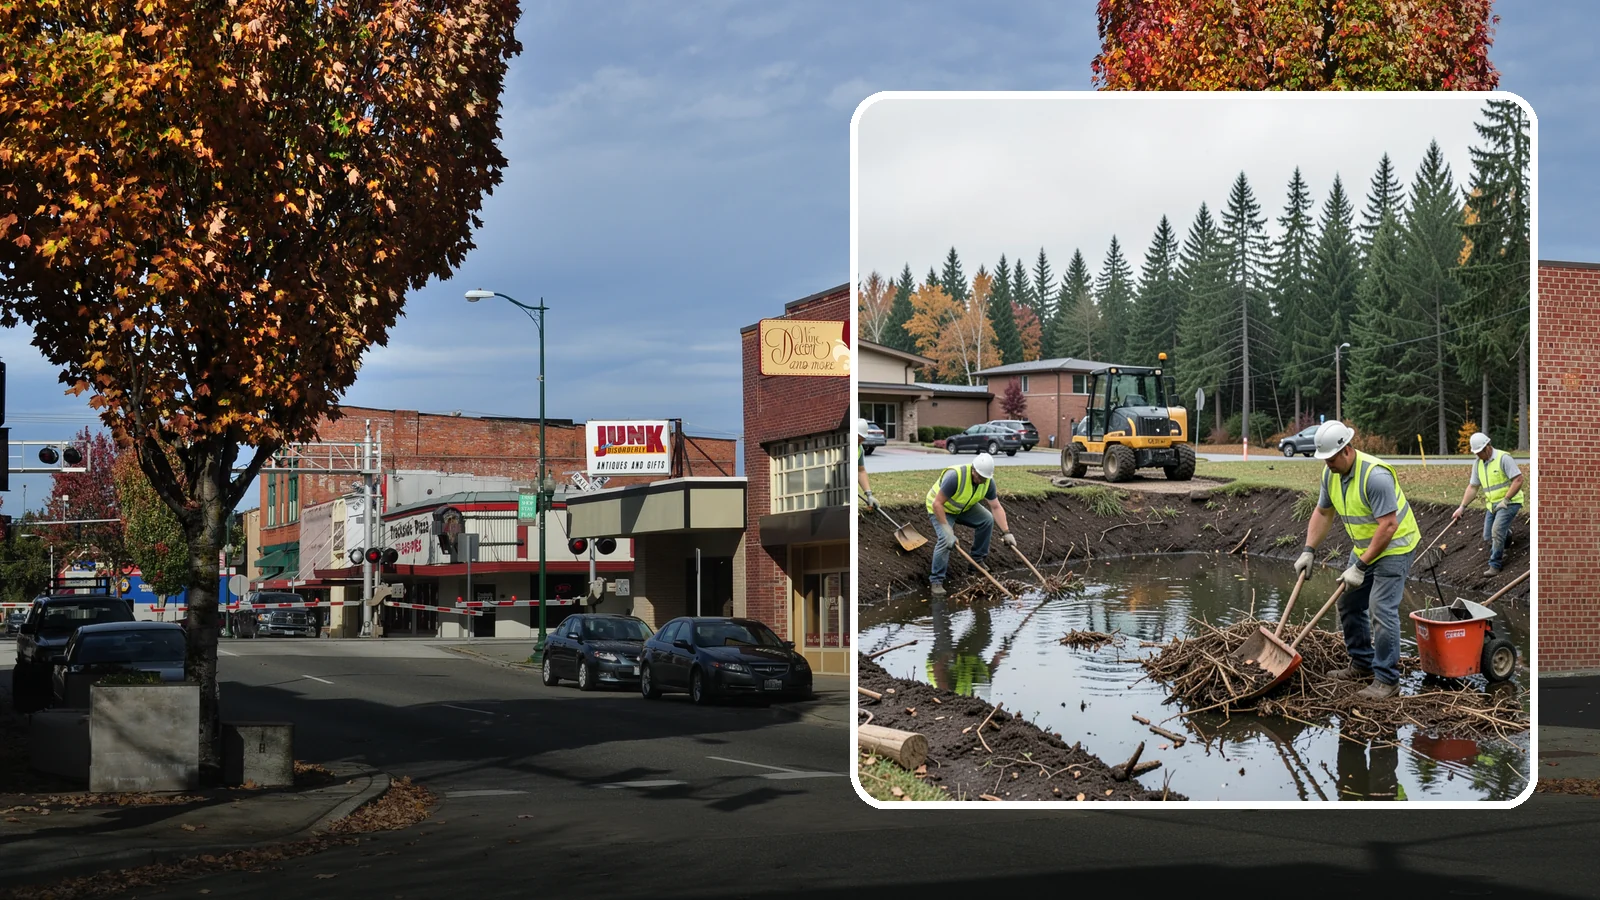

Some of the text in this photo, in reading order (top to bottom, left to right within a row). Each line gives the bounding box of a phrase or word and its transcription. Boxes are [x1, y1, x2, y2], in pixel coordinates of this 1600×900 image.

[765, 327, 830, 365] Decor
[595, 425, 665, 457] JUNK
[607, 446, 646, 454] DISORDERLY
[596, 460, 666, 470] ANTIQUES AND GIFTS
[573, 473, 587, 491] RAIL
[352, 498, 365, 511] CRO
[414, 519, 429, 535] Pizza
